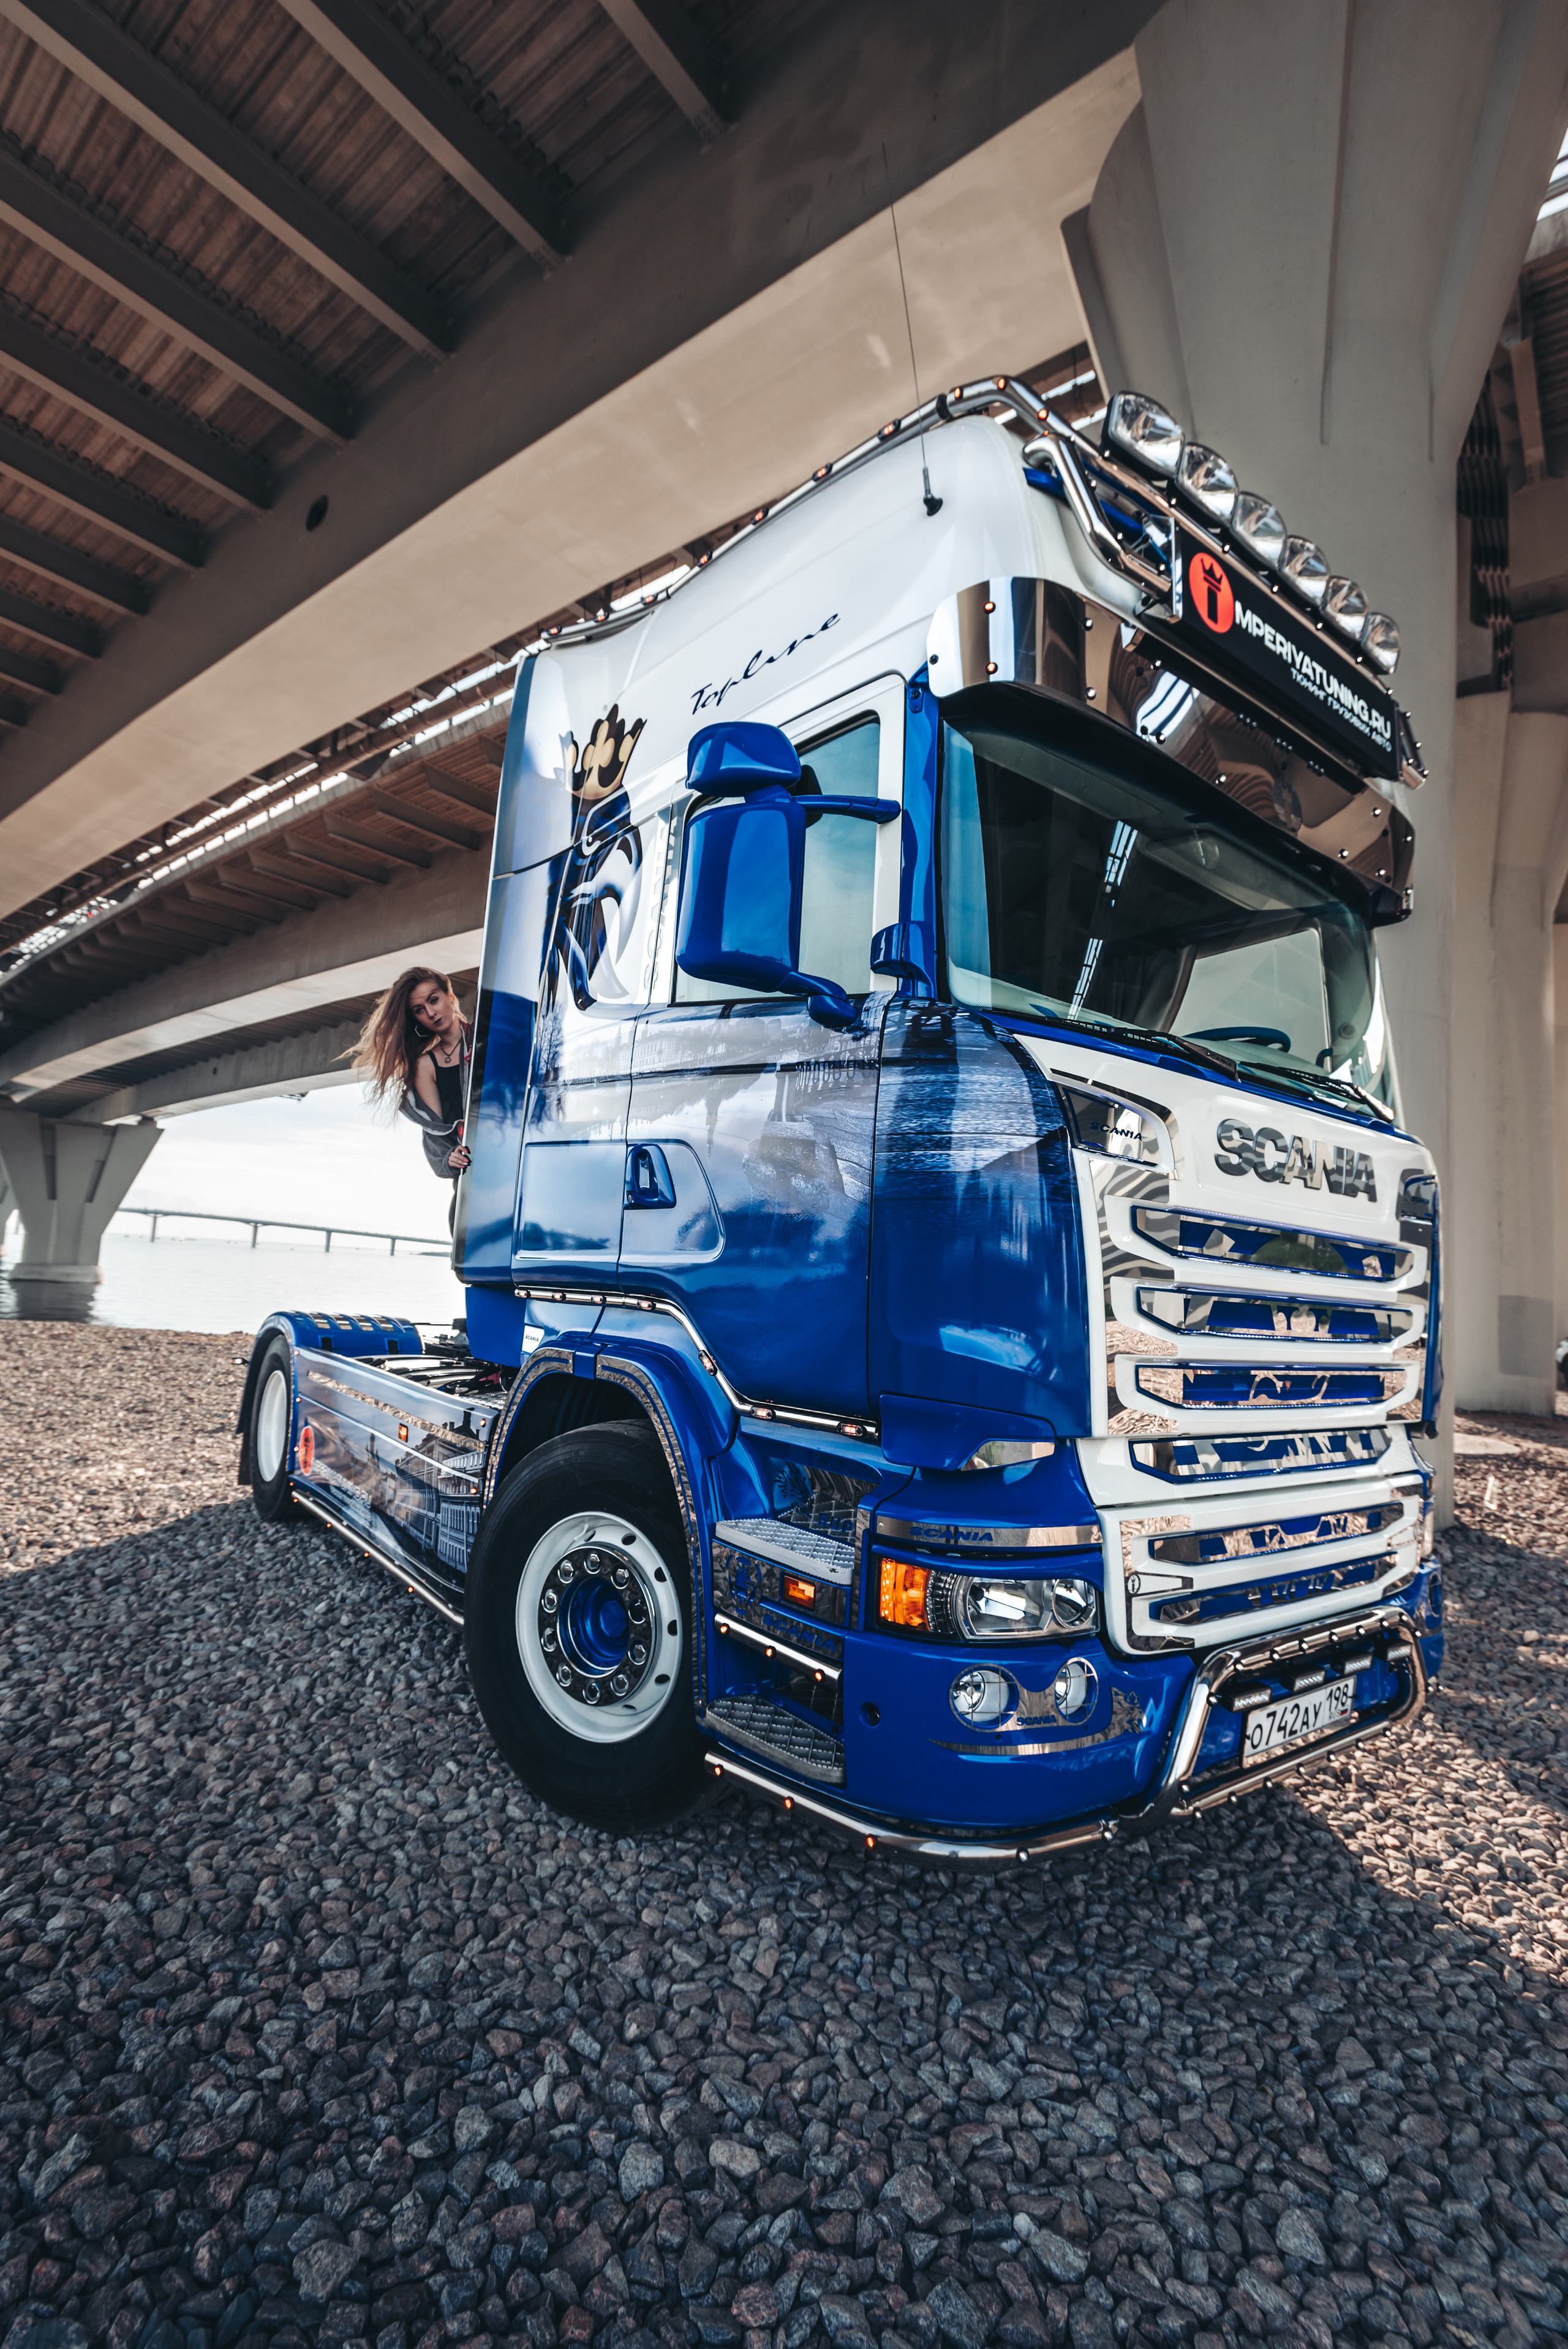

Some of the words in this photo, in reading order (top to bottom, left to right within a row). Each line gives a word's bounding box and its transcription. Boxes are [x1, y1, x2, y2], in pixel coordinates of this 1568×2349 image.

[690, 613, 841, 715] Topline
[1089, 1122, 1142, 1141] SCANIA
[1214, 1118, 1378, 1203] SCANIA
[909, 1526, 993, 1542] SCANIA
[762, 1614, 836, 1652] SCANIA
[1326, 1683, 1349, 1712] 198
[1017, 1714, 1057, 1726] SCANIA
